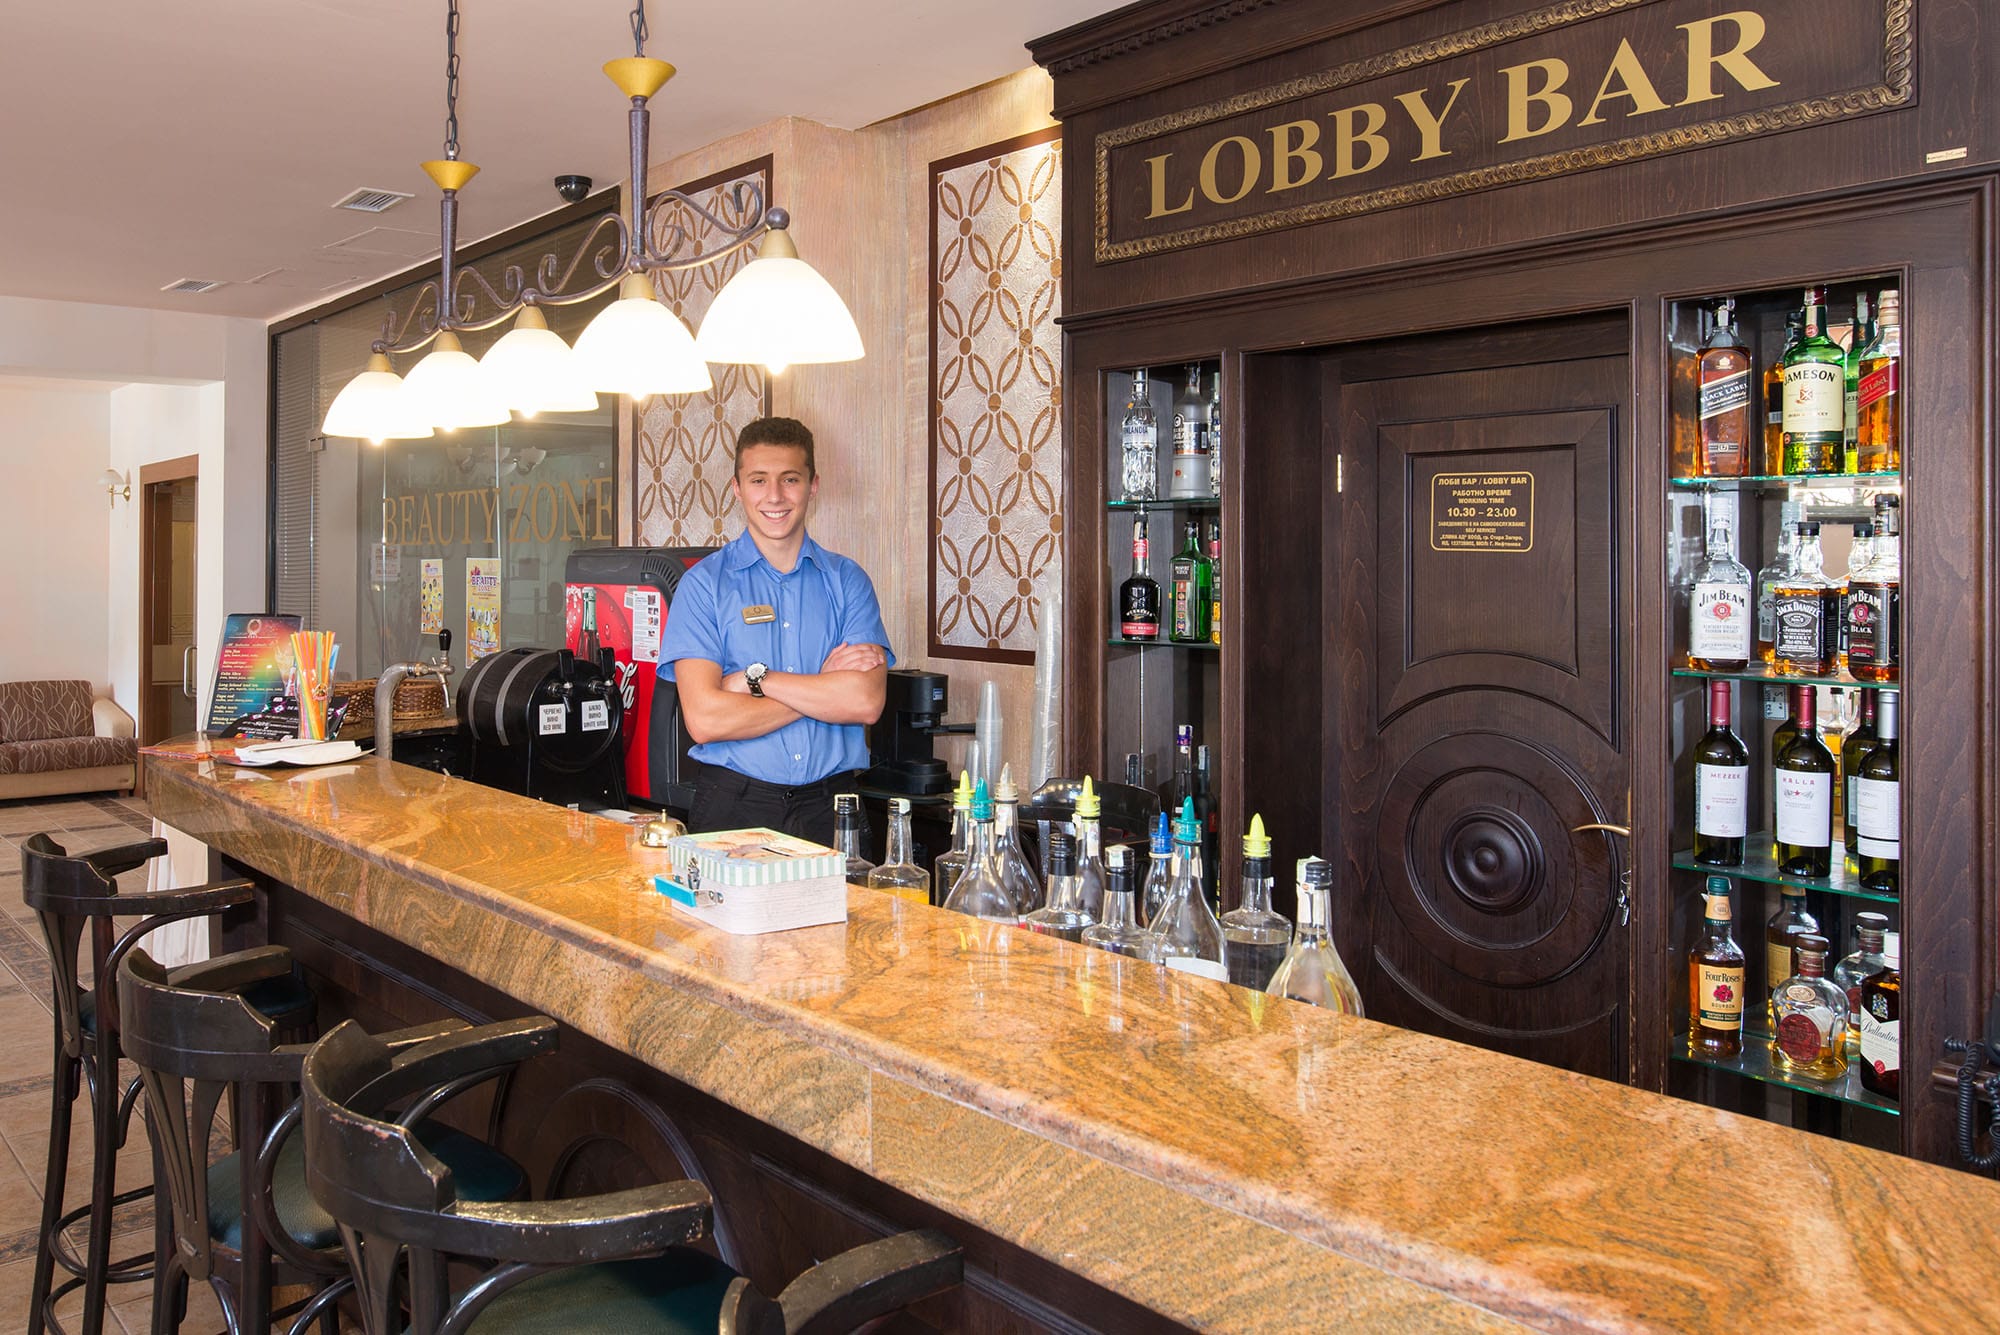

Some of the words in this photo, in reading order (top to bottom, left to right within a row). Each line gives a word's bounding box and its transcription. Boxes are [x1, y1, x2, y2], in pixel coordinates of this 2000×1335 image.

[1144, 79, 1471, 220] LOBBY
[1497, 10, 1781, 144] BAR
[1784, 370, 1835, 386] JAMESON
[1483, 477, 1508, 485] LOBBY
[1510, 477, 1527, 485] BAR
[383, 488, 500, 546] BEAUTY
[509, 477, 613, 543] ZONE
[1447, 507, 1476, 517] 10.30
[1486, 507, 1517, 517] 23.00
[471, 576, 497, 587] BEAUTY
[1699, 593, 1717, 607] JIM
[1719, 589, 1745, 608] BEAM
[1858, 589, 1882, 611] BEAM
[1776, 603, 1793, 617] JACK
[1850, 625, 1872, 634] BLACK
[1705, 970, 1721, 980] Four
[1721, 973, 1740, 982] Roses
